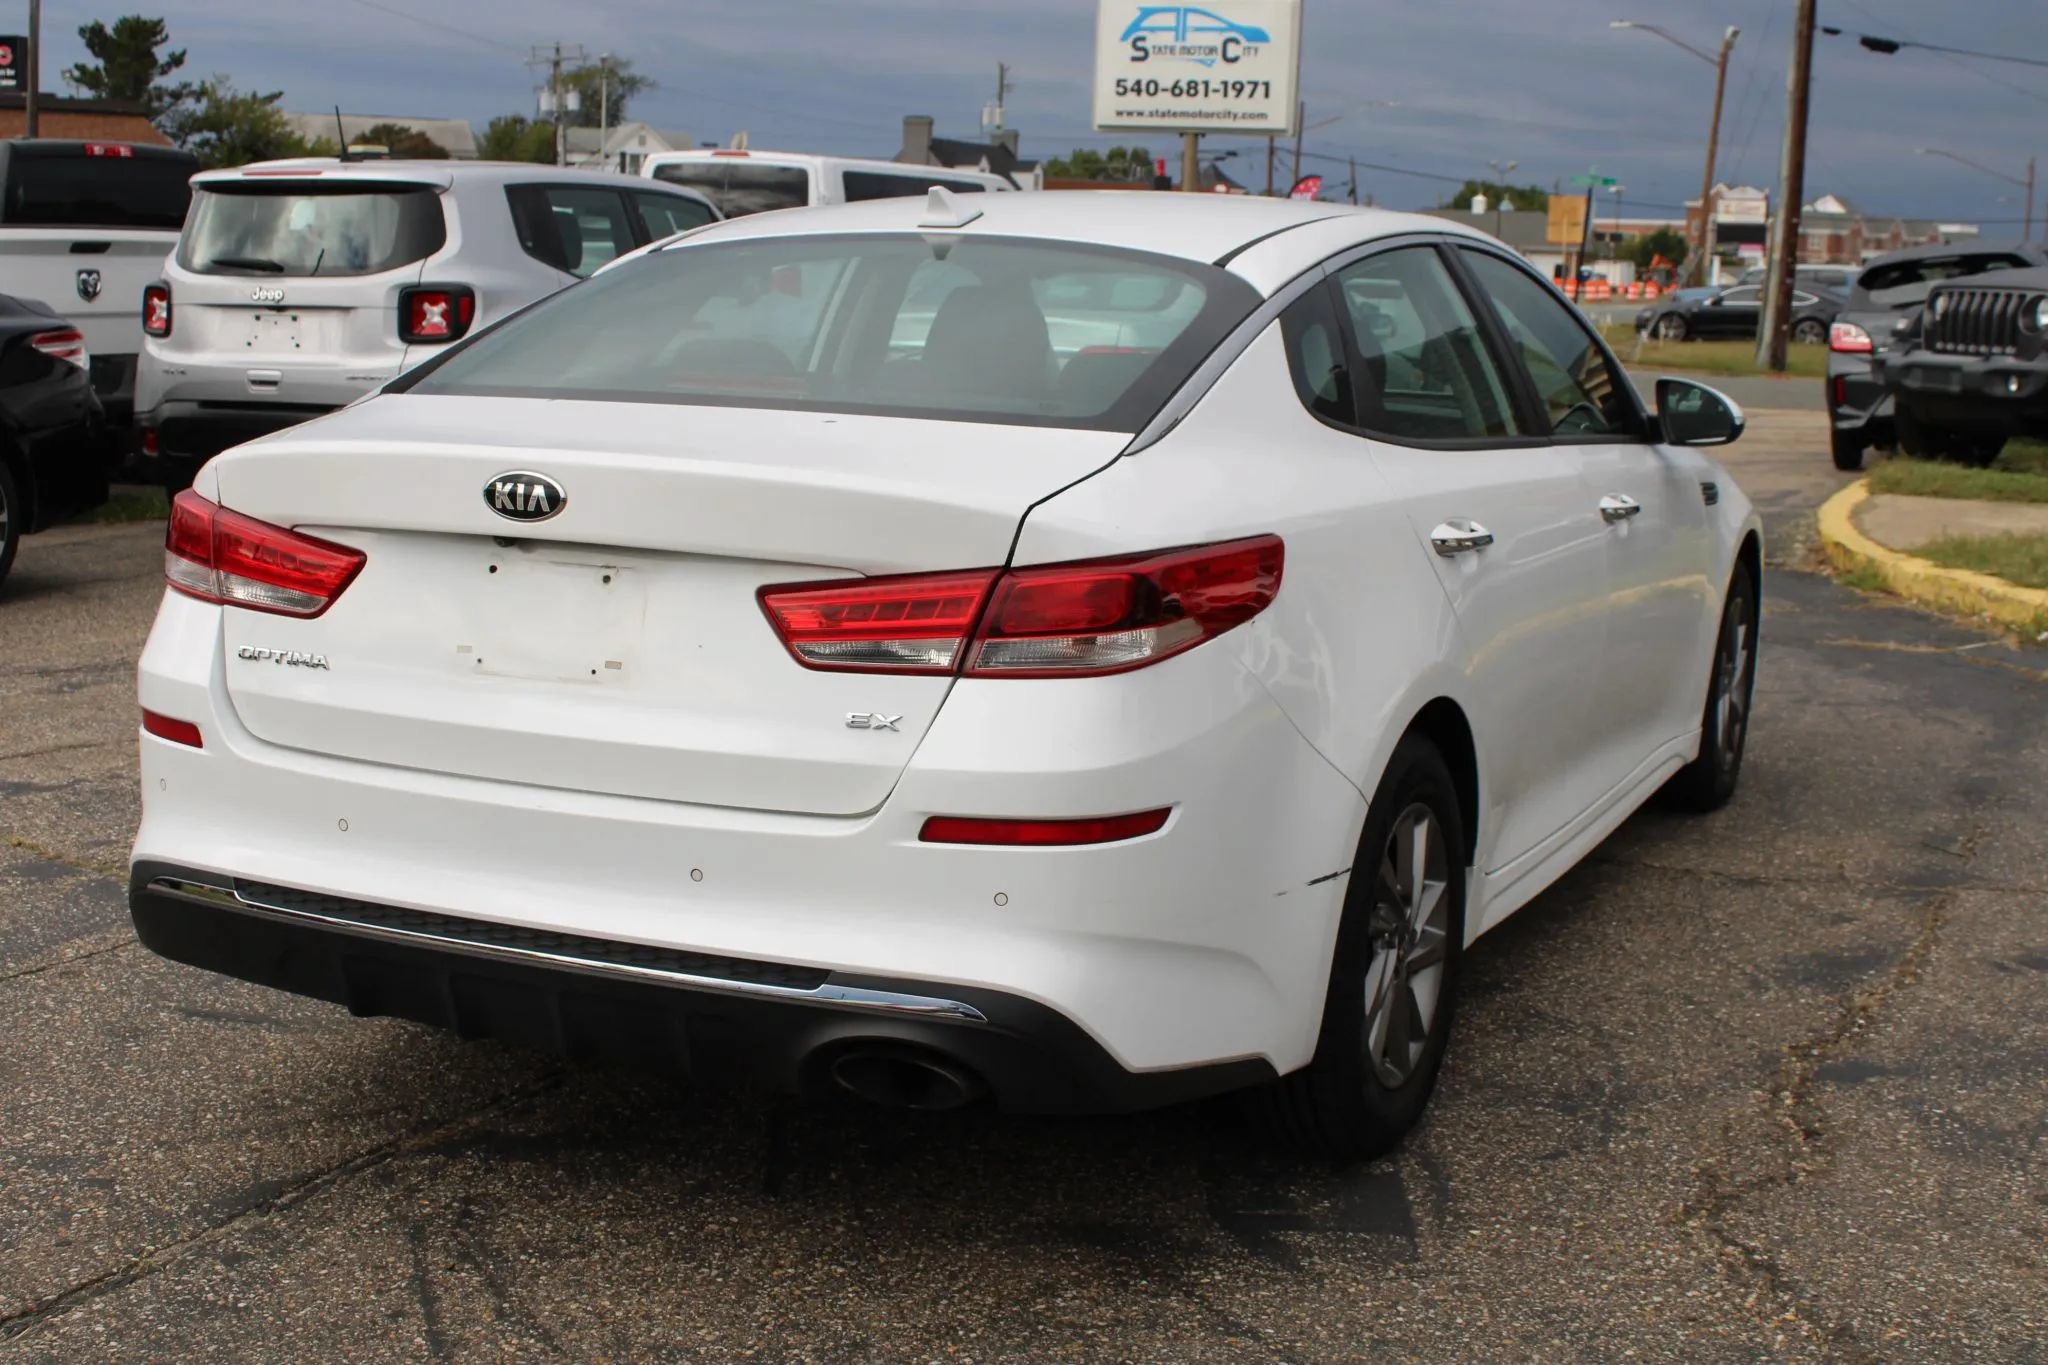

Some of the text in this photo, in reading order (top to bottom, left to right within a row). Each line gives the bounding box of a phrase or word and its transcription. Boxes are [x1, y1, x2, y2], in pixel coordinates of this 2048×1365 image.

[1115, 79, 1270, 99] 540-681-1971
[1115, 109, 1268, 121] www.statemotorcity.com
[251, 286, 284, 303] Jeep
[495, 481, 551, 512] KIA
[238, 645, 330, 671] OPTIMA
[845, 712, 904, 732] EX
